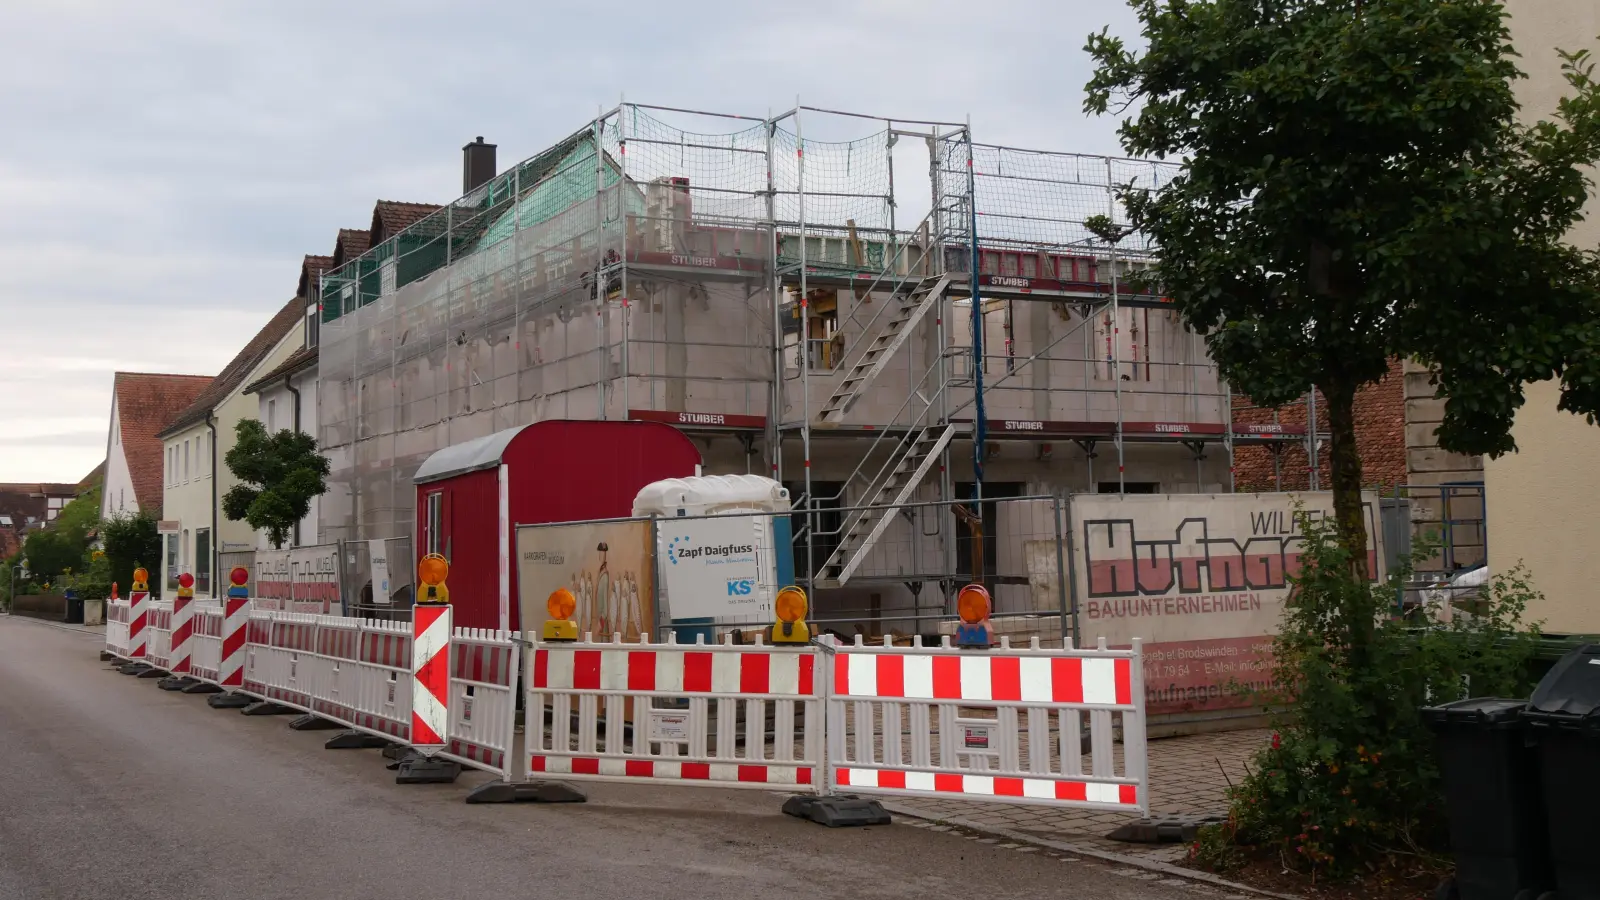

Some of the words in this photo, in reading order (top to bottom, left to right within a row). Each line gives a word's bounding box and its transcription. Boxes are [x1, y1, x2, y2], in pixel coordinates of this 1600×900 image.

[991, 276, 1029, 287] STUIBER
[678, 412, 725, 424] STUIBER
[1005, 420, 1044, 430] STUIBER
[1155, 424, 1190, 433] STUIBER
[1250, 509, 1335, 535] WILHEL
[678, 547, 703, 559] Zapf
[704, 544, 753, 557] Daigfuss
[727, 580, 752, 596] KS
[1088, 594, 1261, 619] BAUUNTERNEHMEN
[1178, 645, 1238, 661] Brodswinden
[1204, 661, 1237, 674] E-Mail:
